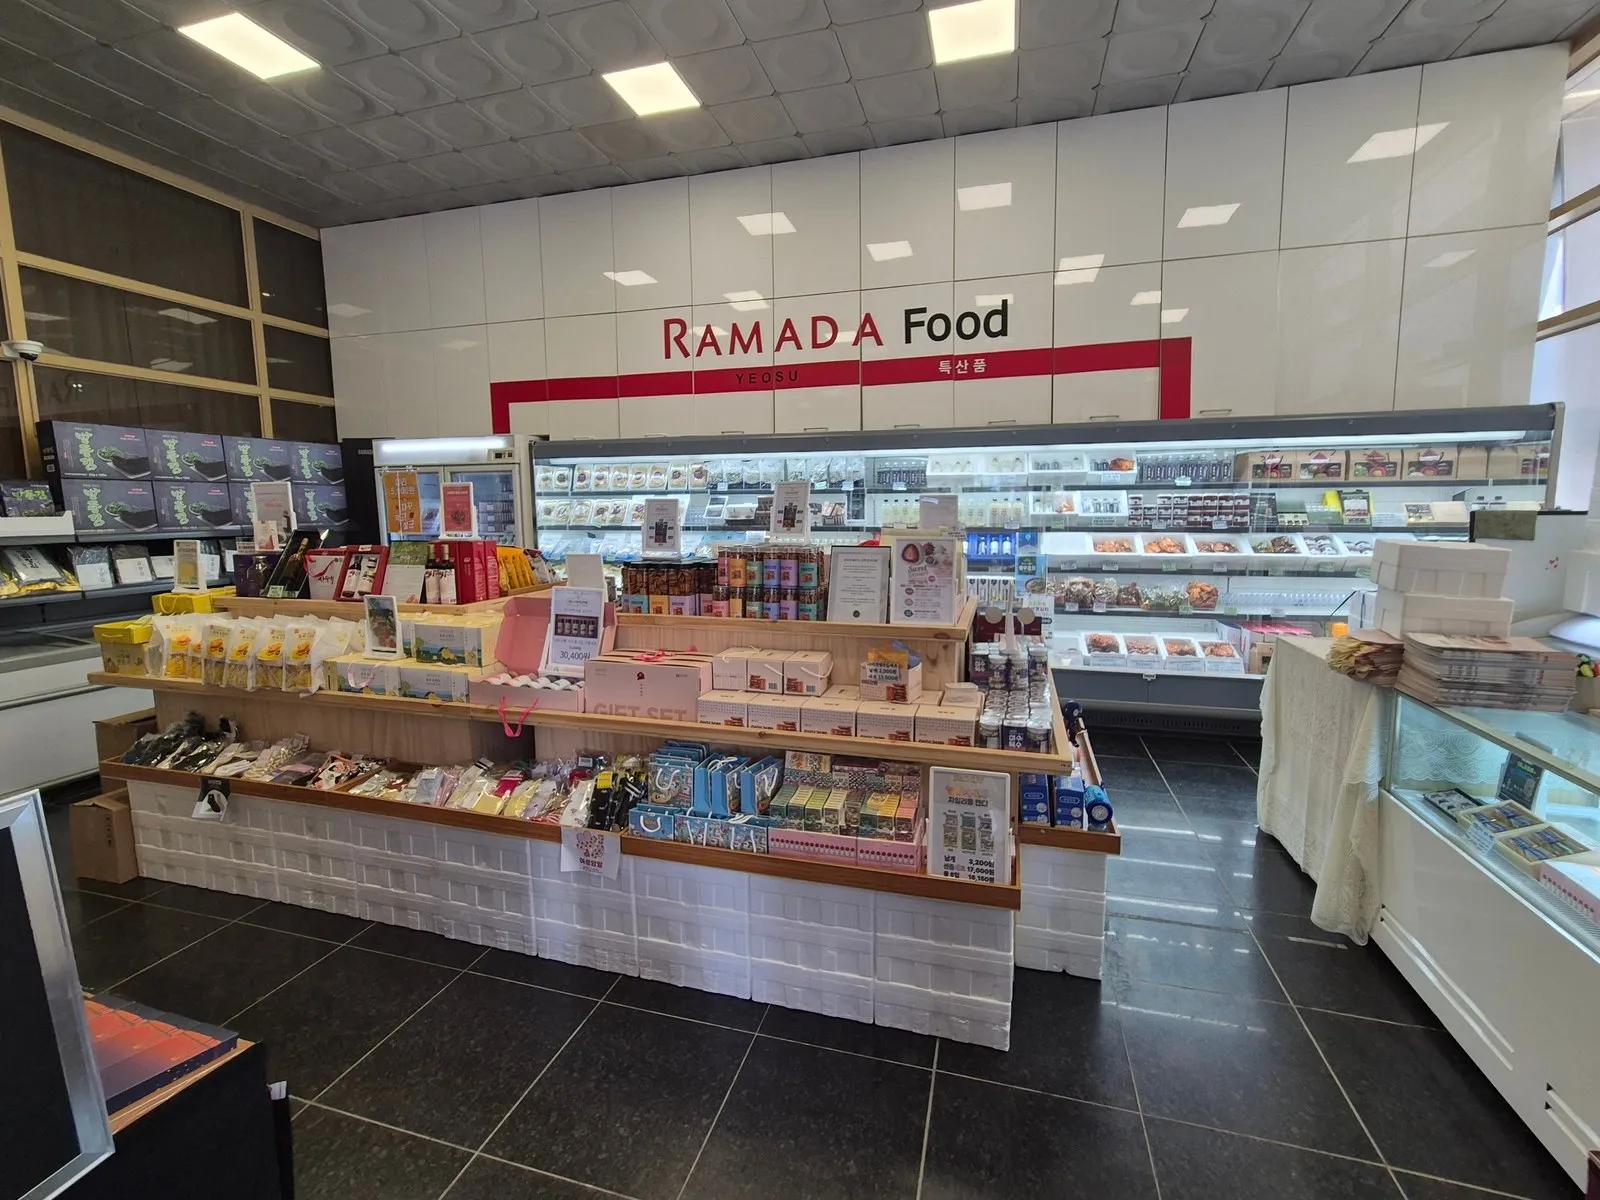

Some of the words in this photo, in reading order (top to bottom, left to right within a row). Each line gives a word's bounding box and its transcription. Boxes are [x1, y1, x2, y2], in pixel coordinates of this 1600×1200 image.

[664, 313, 884, 360] RAMADA
[904, 299, 1009, 344] Food
[937, 358, 987, 375] 특산품
[735, 370, 798, 385] YEOSU
[593, 702, 641, 717] GIFT
[646, 706, 687, 721] SET
[947, 796, 974, 806] 자일리톨
[975, 799, 989, 807] 캔디
[968, 858, 995, 868] 3,200원
